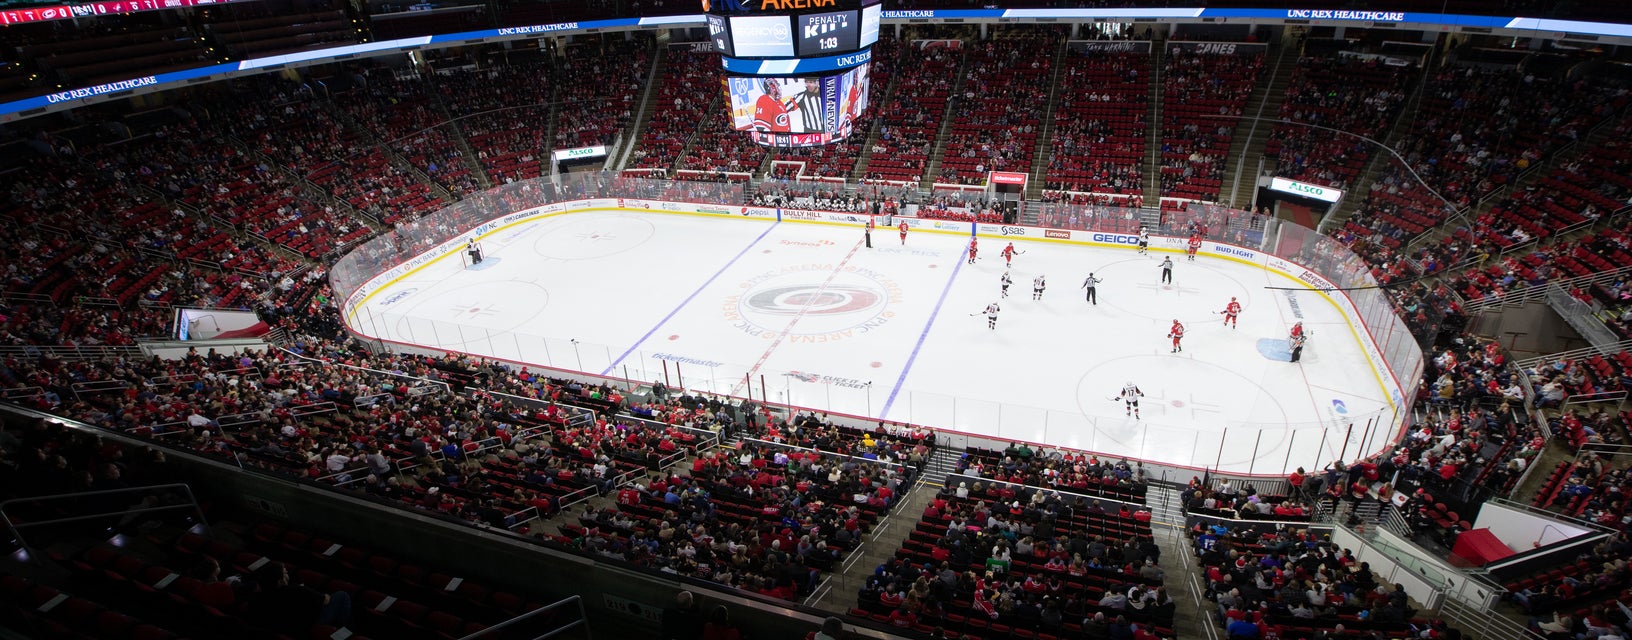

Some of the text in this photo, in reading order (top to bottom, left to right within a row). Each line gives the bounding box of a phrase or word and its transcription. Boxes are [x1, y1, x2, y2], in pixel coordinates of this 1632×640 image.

[809, 14, 848, 26] PENALTY
[885, 10, 935, 18] HEALTHCARE
[1287, 9, 1405, 21] UNC REX HEALTHCARE
[498, 22, 579, 36] UNC REX HEALTHCARE
[690, 43, 713, 53] CANE
[819, 37, 838, 50] 1:03
[1195, 43, 1238, 55] CANES
[836, 55, 855, 67] UNC
[855, 52, 868, 65] REX
[46, 75, 158, 104] UNC REX HEALTHCARE
[826, 102, 836, 133] NEWS
[568, 147, 594, 156] ALSCO
[1288, 180, 1324, 196] ALSCO
[783, 209, 823, 218] BULLY HILL
[1008, 226, 1026, 236] sas
[1045, 230, 1069, 238] Lenovo
[1093, 233, 1139, 245] GEICO
[1215, 245, 1255, 260] BUD LIGHT
[1302, 270, 1327, 287] Advance
[1127, 389, 1135, 398] 17
